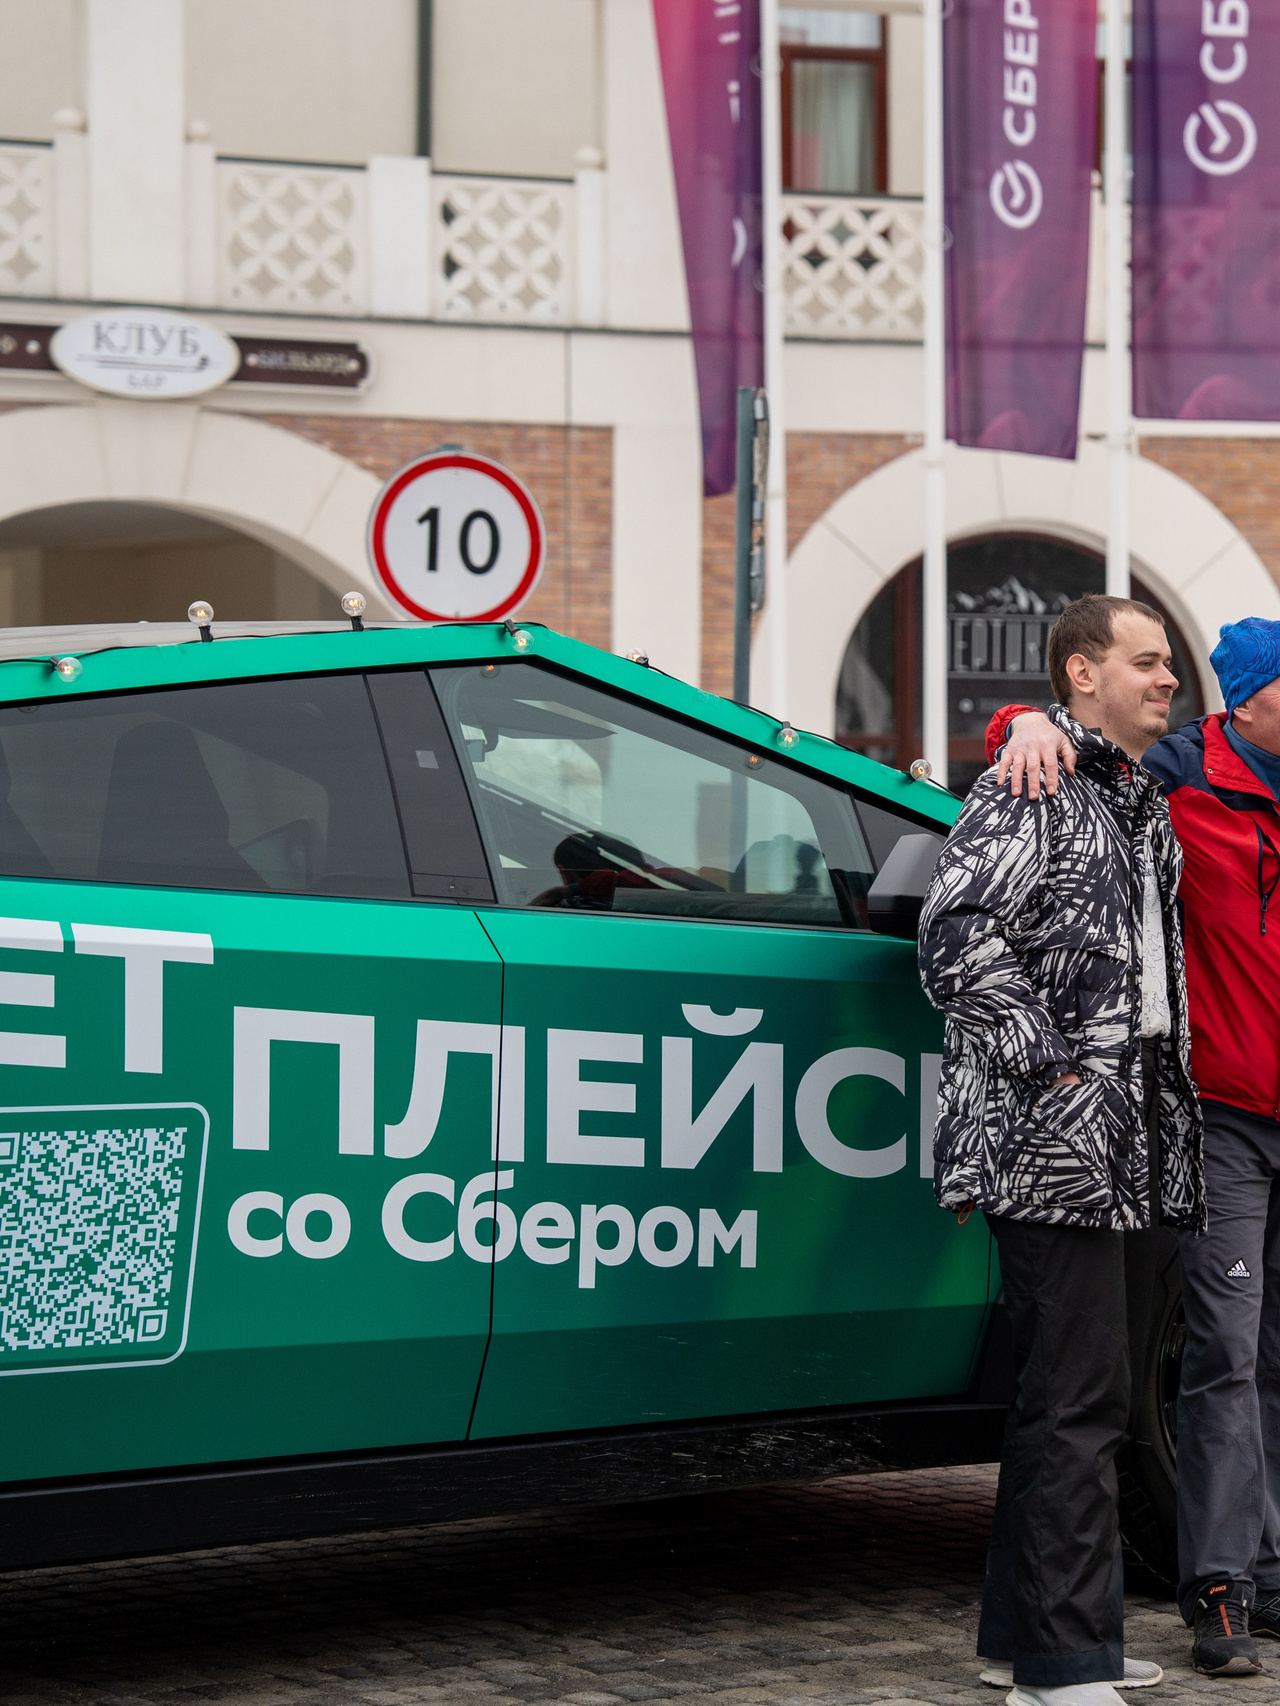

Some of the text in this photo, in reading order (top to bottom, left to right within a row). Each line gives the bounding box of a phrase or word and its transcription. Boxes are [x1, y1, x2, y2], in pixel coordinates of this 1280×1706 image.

[1002, 0, 1039, 147] СБЕР
[92, 321, 201, 359] КЛУБ
[417, 507, 500, 575] 10
[227, 1168, 759, 1289] со Сбером
[1227, 1269, 1250, 1278] adidas
